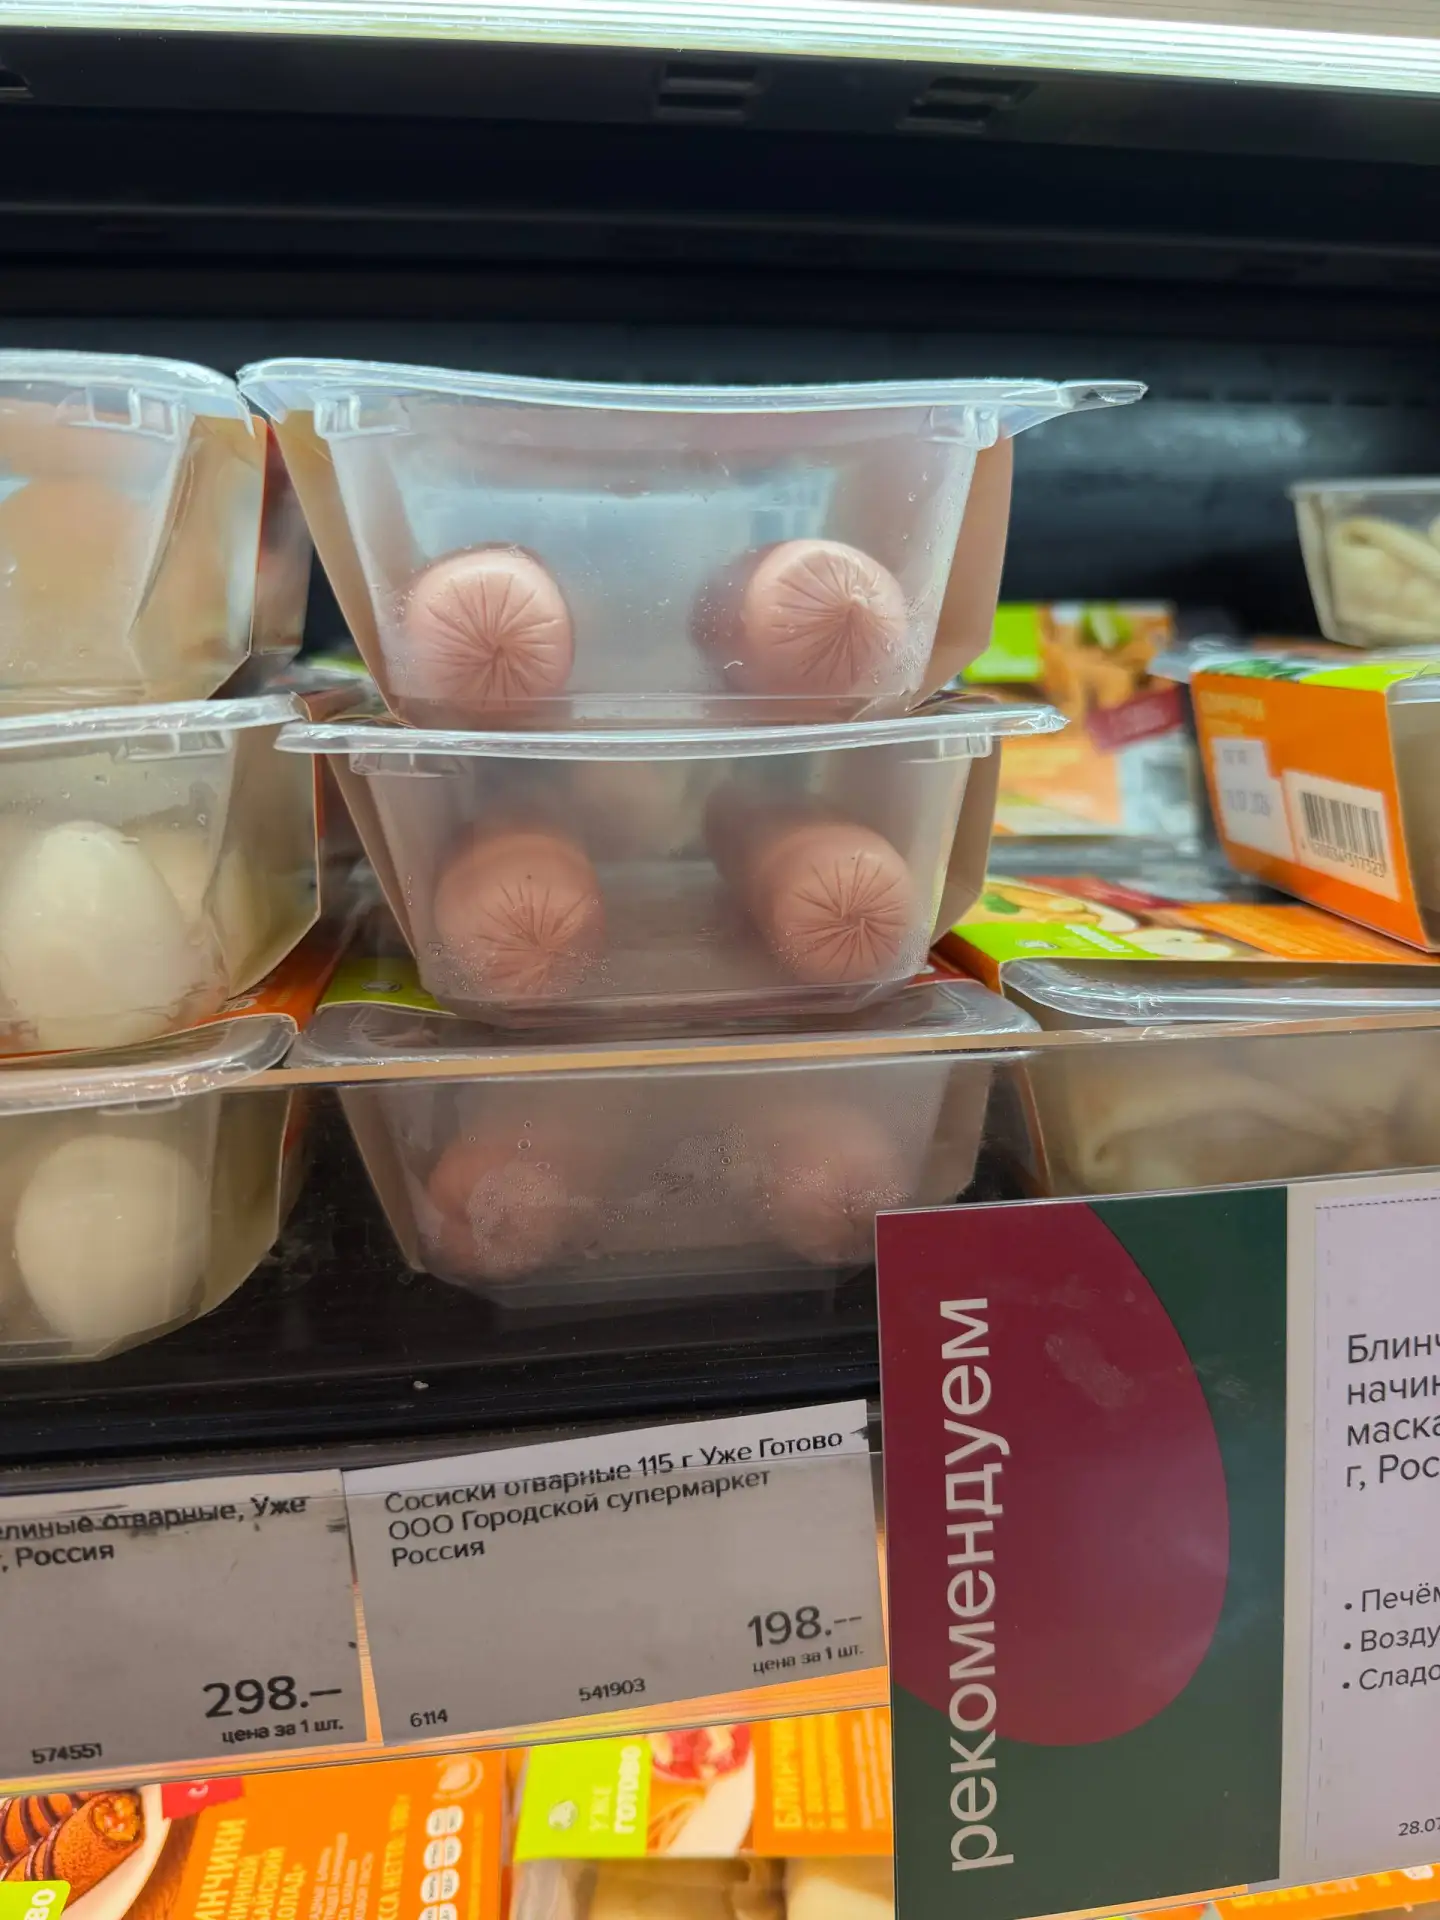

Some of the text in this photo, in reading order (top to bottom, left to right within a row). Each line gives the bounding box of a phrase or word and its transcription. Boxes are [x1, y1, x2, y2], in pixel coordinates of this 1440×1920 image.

[1348, 1333, 1440, 1364] Блин
[385, 1431, 843, 1513] Сосиски отварные 115 г Уже Готово
[1346, 1454, 1440, 1491] г, Рос
[102, 1502, 244, 1533] отварные,
[250, 1495, 308, 1518] Уже
[388, 1469, 772, 1540] ООО Городской супермаркет
[15, 1544, 115, 1568] Россия
[391, 1537, 486, 1567] Россия
[940, 1297, 1014, 1872] рекомендуем
[1361, 1625, 1440, 1652] Возду
[752, 1644, 864, 1675] цена за 1 шт.
[579, 1677, 646, 1702] 541903
[1359, 1664, 1440, 1690] Сладо
[221, 1717, 344, 1745] цена за 1 шт.
[409, 1708, 449, 1728] 6114
[31, 1742, 103, 1765] 574551
